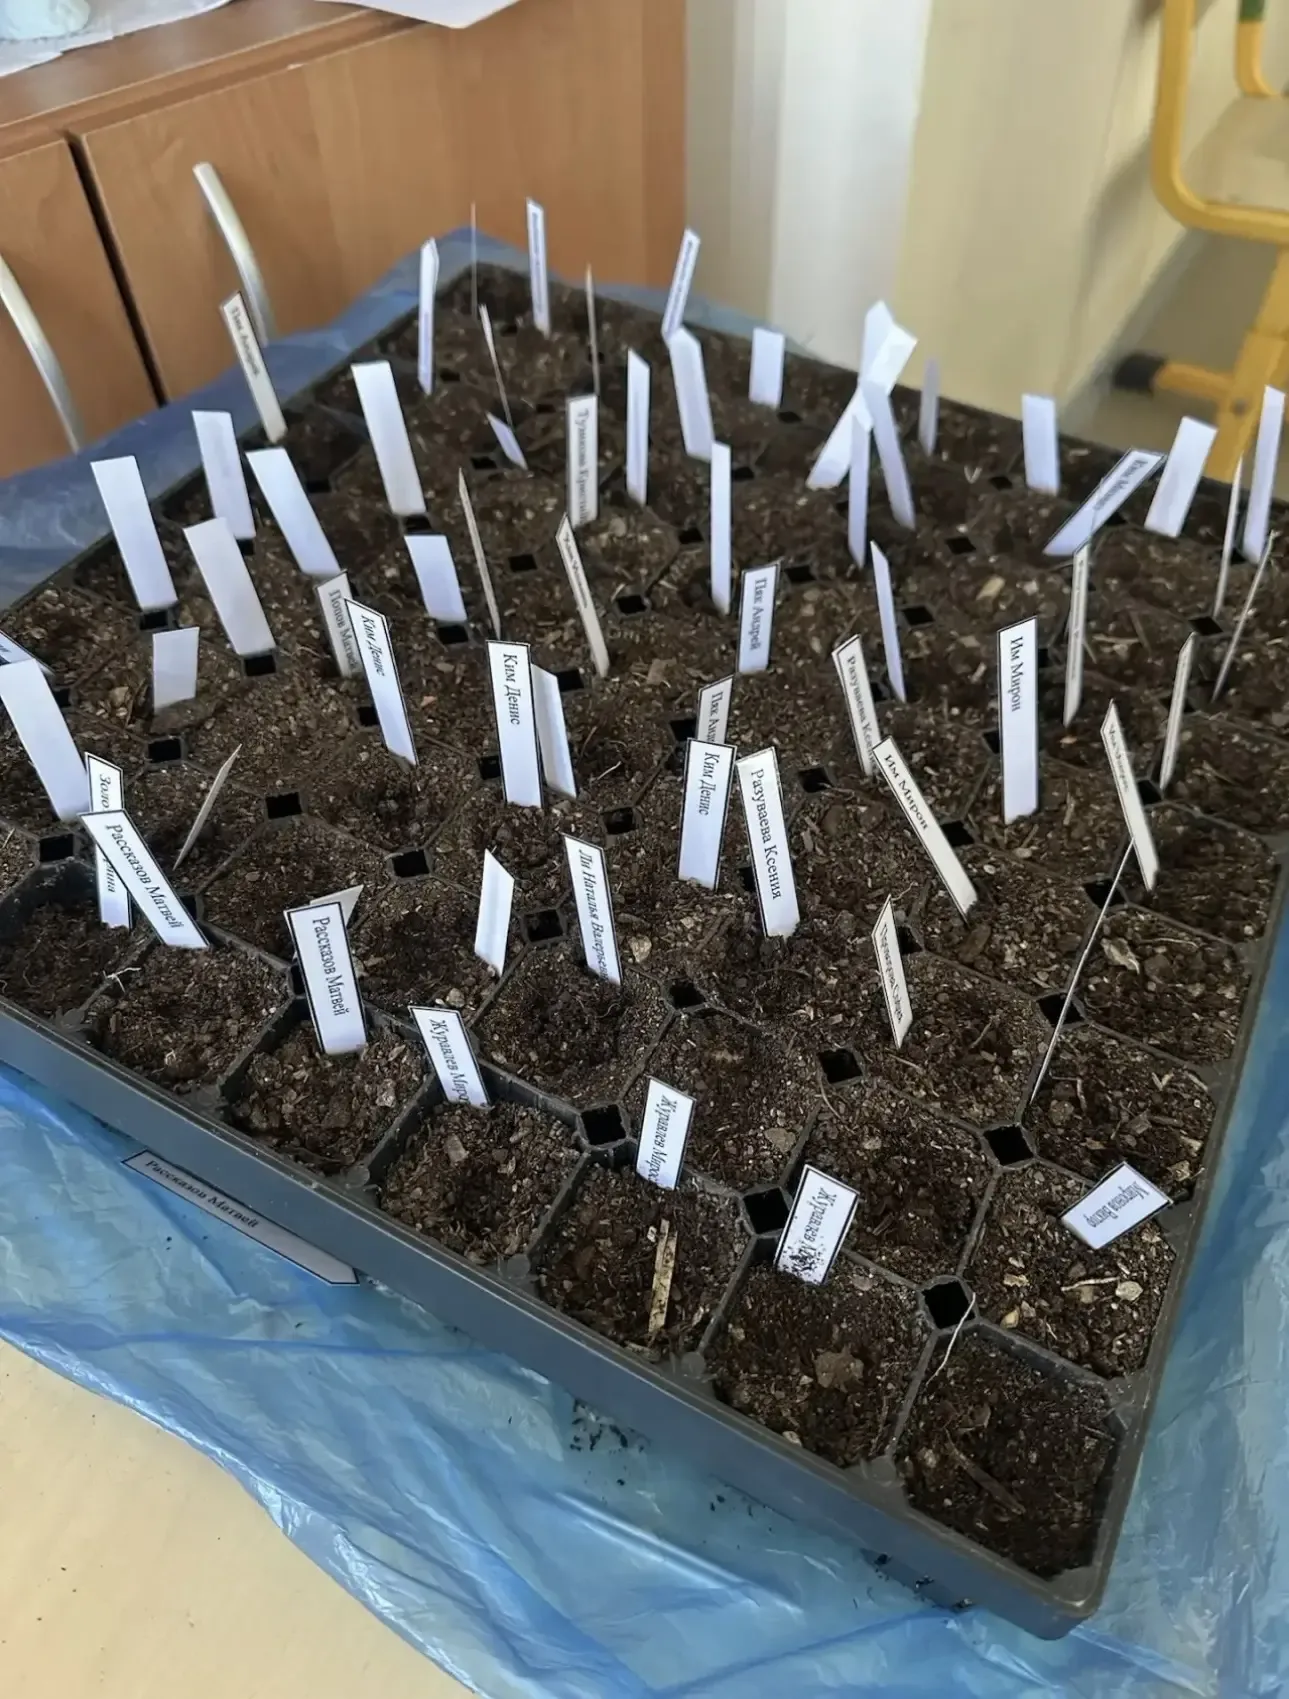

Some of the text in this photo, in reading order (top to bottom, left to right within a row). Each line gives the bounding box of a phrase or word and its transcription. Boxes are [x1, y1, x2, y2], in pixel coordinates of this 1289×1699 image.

[361, 614, 386, 677] Ким Денис
[748, 608, 764, 651] Андрей
[503, 653, 521, 725] Ким Денис
[1008, 636, 1024, 712] Им Мирон
[698, 752, 720, 816] Ким Денис
[884, 754, 928, 830] Им Мирон
[579, 849, 591, 864] Ли
[751, 768, 782, 900] Разуваева Ксения
[106, 823, 185, 929] Рассказов Матвей
[582, 866, 600, 921] Наталья
[312, 916, 350, 1017] Рассказов Матвей
[430, 1018, 470, 1104] Журавлев Миро
[655, 1094, 678, 1149] Журавлев
[145, 1159, 260, 1229] Рассказов Матвей
[804, 1187, 838, 1241] Журавлев
